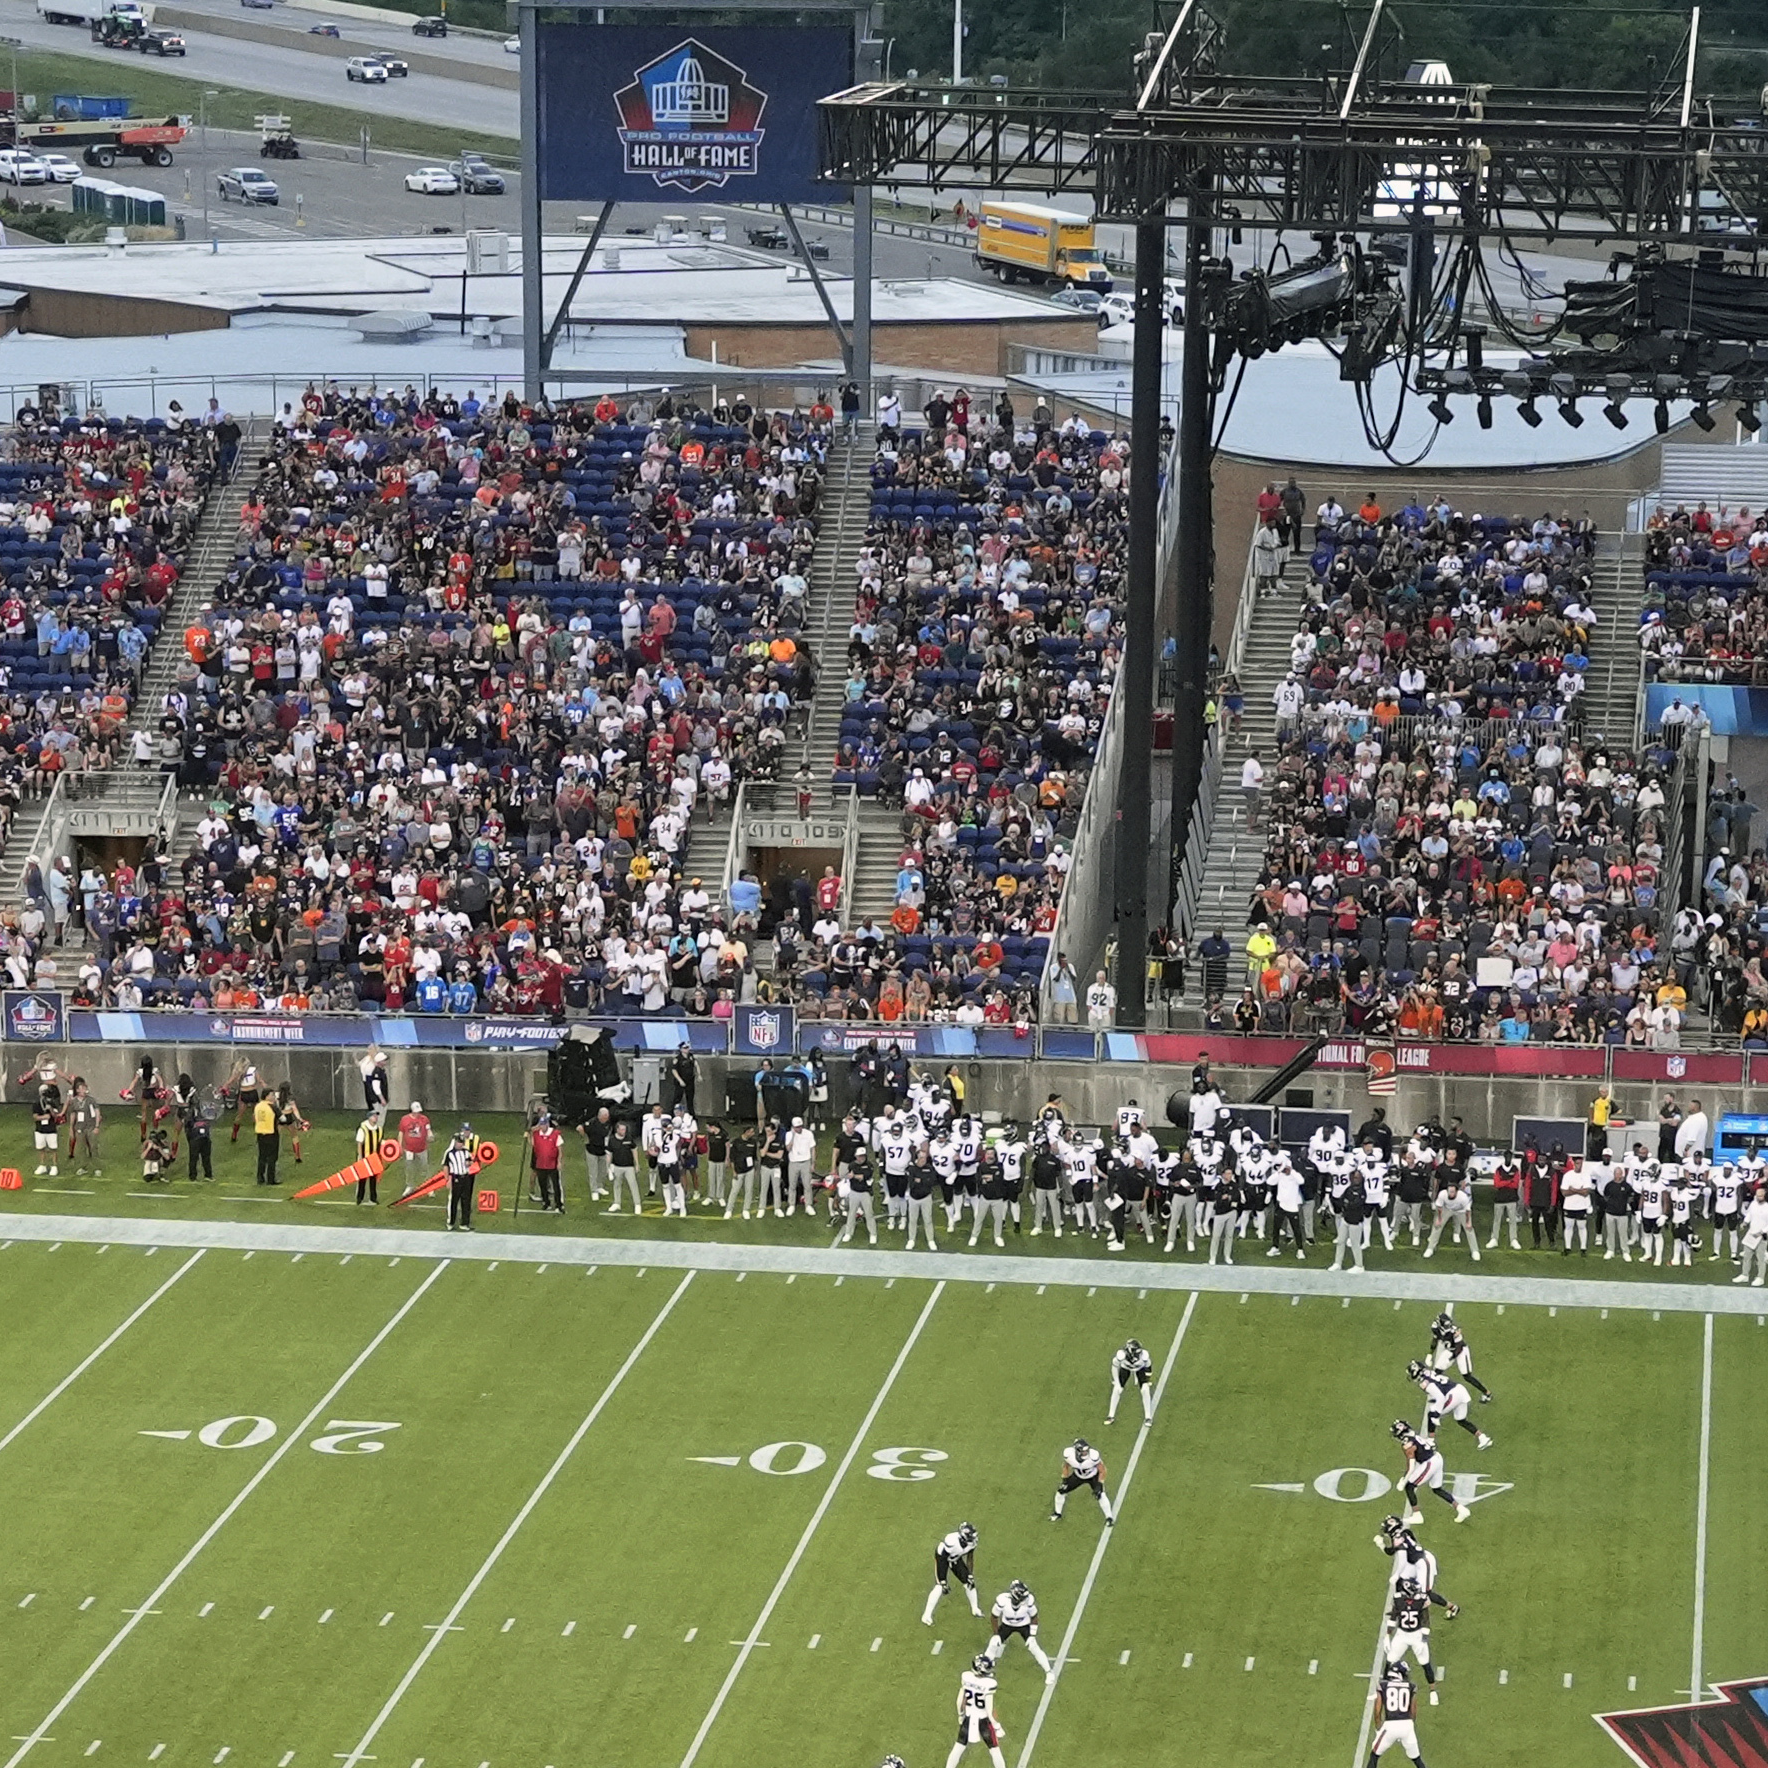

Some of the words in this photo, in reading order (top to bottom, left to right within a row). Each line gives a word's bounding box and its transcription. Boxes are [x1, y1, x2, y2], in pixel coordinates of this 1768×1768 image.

[626, 131, 662, 141] PRO
[668, 131, 755, 142] FOOTBALL
[631, 145, 684, 167] HALL
[684, 147, 697, 158] OF
[697, 145, 751, 167] FAME
[760, 825, 791, 837] 110
[805, 825, 839, 838] 109
[1091, 992, 1108, 1006] 92
[753, 1027, 775, 1043] NFL
[1396, 1047, 1430, 1066] LEAGUE
[887, 1146, 904, 1159] 57
[1000, 1152, 1016, 1165] 76
[1072, 1159, 1085, 1172] 10
[1247, 1170, 1263, 1182] 44
[1365, 1177, 1380, 1189] 17
[1717, 1187, 1734, 1198] 32
[1399, 1609, 1420, 1631] 25
[964, 1689, 987, 1711] 26
[1385, 1685, 1411, 1713] 80
